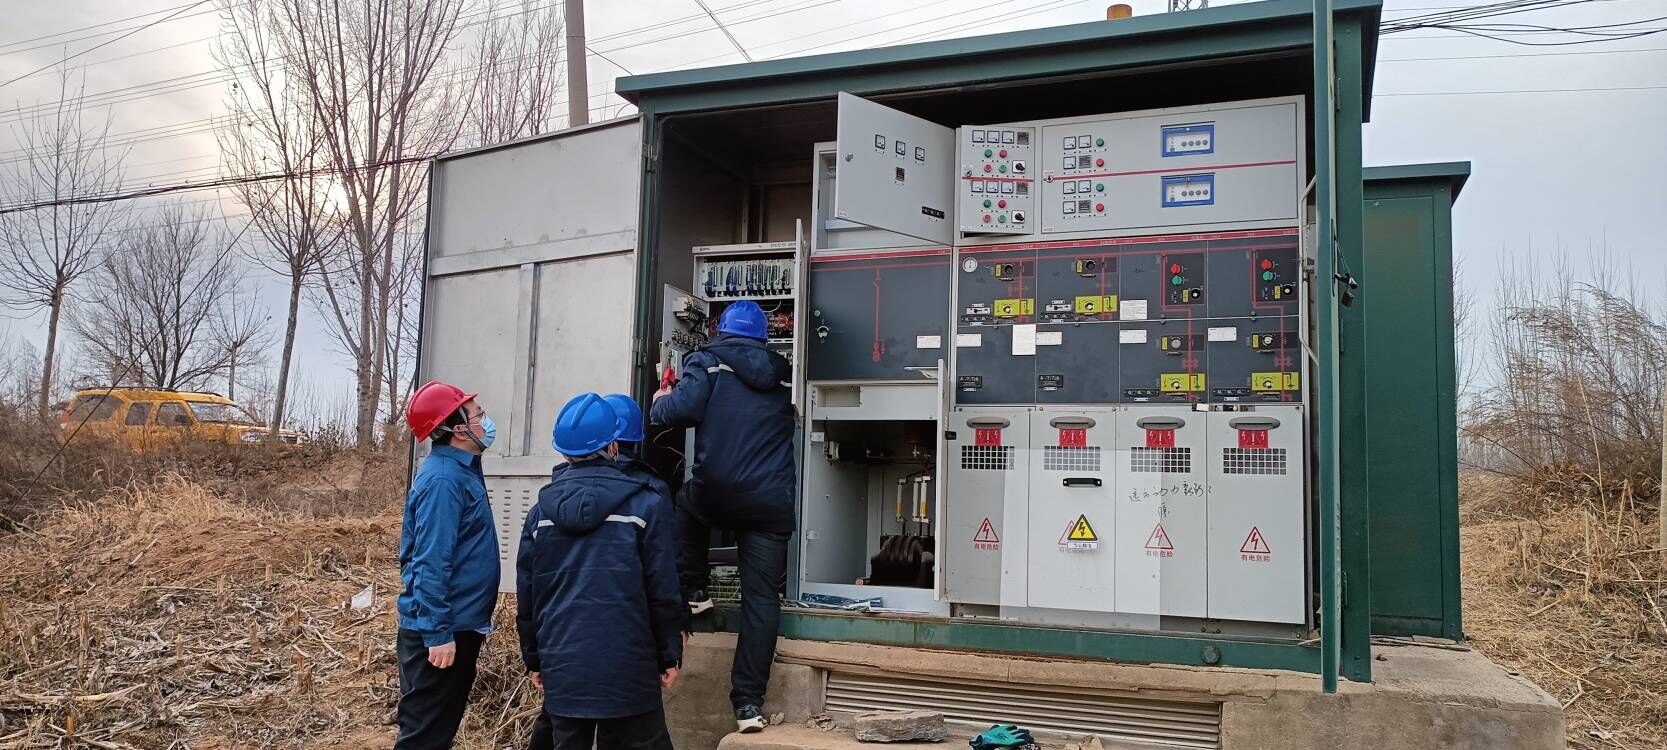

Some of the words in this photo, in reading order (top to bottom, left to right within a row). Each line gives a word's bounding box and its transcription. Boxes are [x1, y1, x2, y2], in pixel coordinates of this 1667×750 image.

[1146, 550, 1173, 558] 有电危险
[1241, 554, 1270, 562] 有电危险
